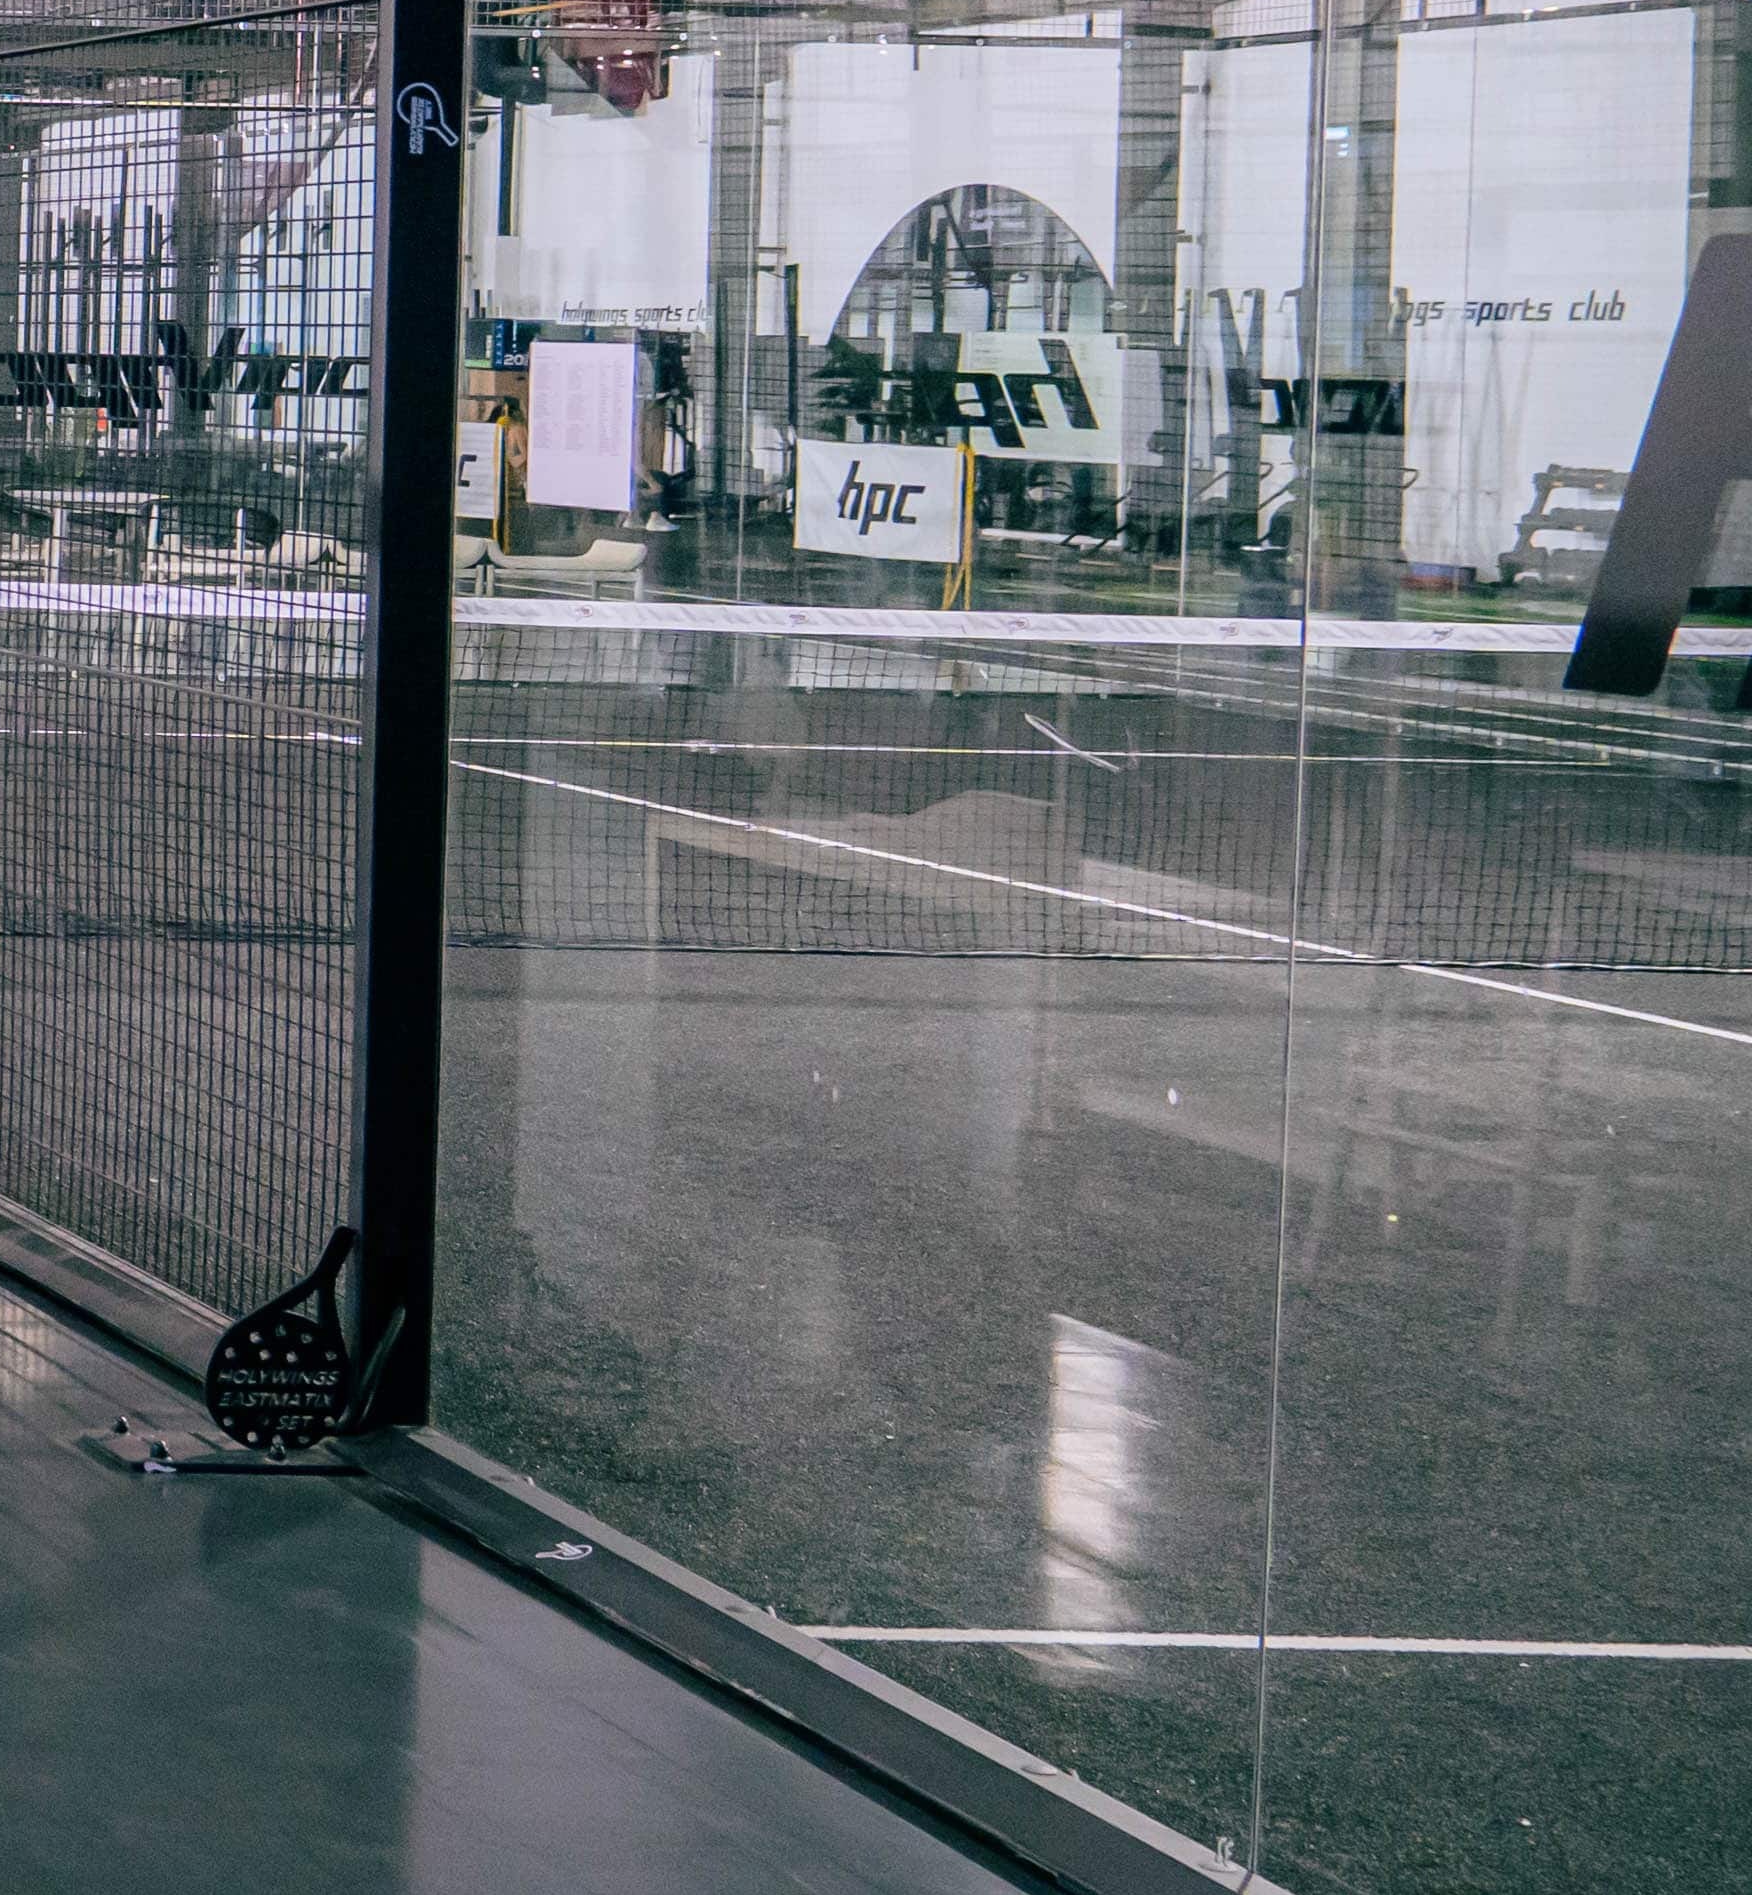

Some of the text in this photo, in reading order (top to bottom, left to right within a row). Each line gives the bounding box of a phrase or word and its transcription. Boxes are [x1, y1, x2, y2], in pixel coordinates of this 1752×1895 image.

[561, 300, 628, 323] holywings
[634, 303, 683, 326] sports
[1463, 300, 1553, 327] sports
[1568, 288, 1625, 322] club
[837, 460, 926, 536] hpc
[217, 1368, 342, 1386] HOLYWINGS
